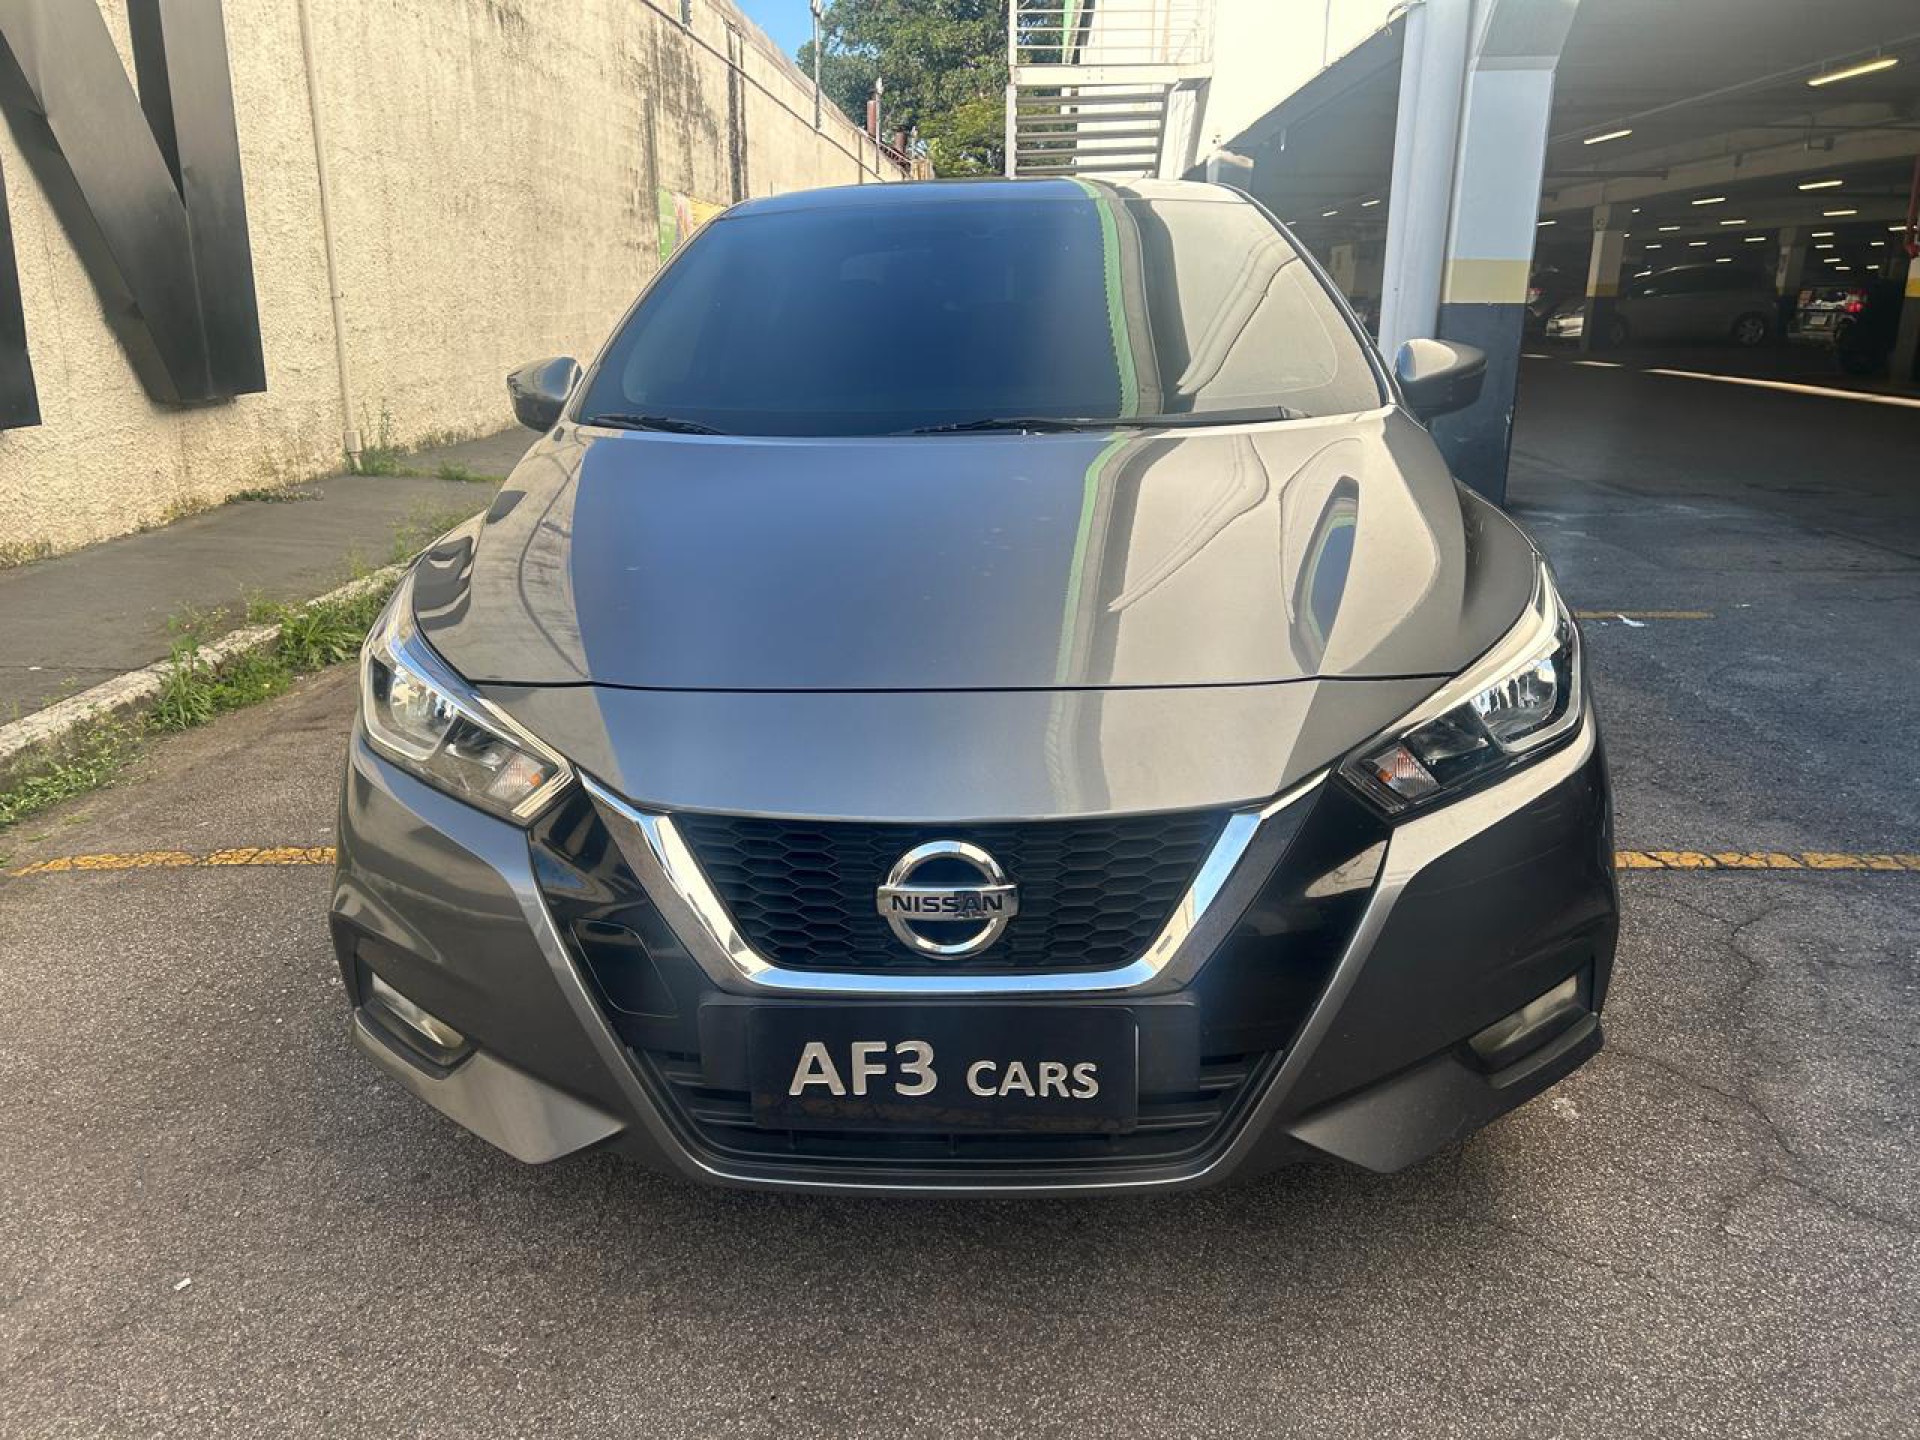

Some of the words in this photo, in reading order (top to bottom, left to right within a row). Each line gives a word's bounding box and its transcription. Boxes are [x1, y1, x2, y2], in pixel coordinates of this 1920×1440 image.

[891, 894, 1003, 913] NISSAN
[788, 1040, 938, 1097] AF3
[966, 1060, 1100, 1099] CARS
